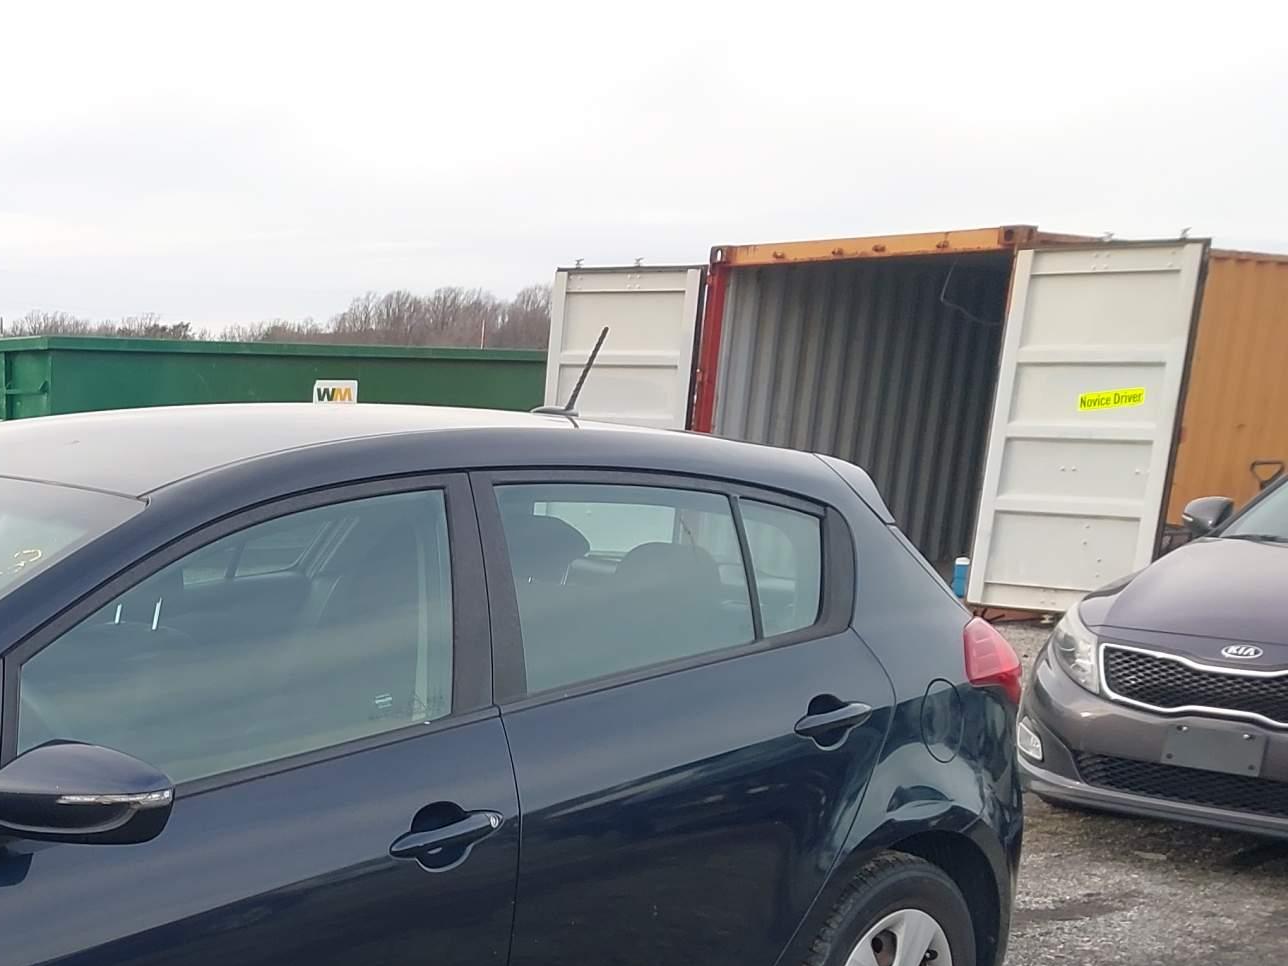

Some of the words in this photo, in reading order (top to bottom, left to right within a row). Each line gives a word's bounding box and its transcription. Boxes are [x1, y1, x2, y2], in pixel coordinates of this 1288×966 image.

[316, 387, 352, 401] WM
[1079, 395, 1110, 408] Novice
[1113, 392, 1144, 404] Driver
[1227, 646, 1255, 656] KIA
